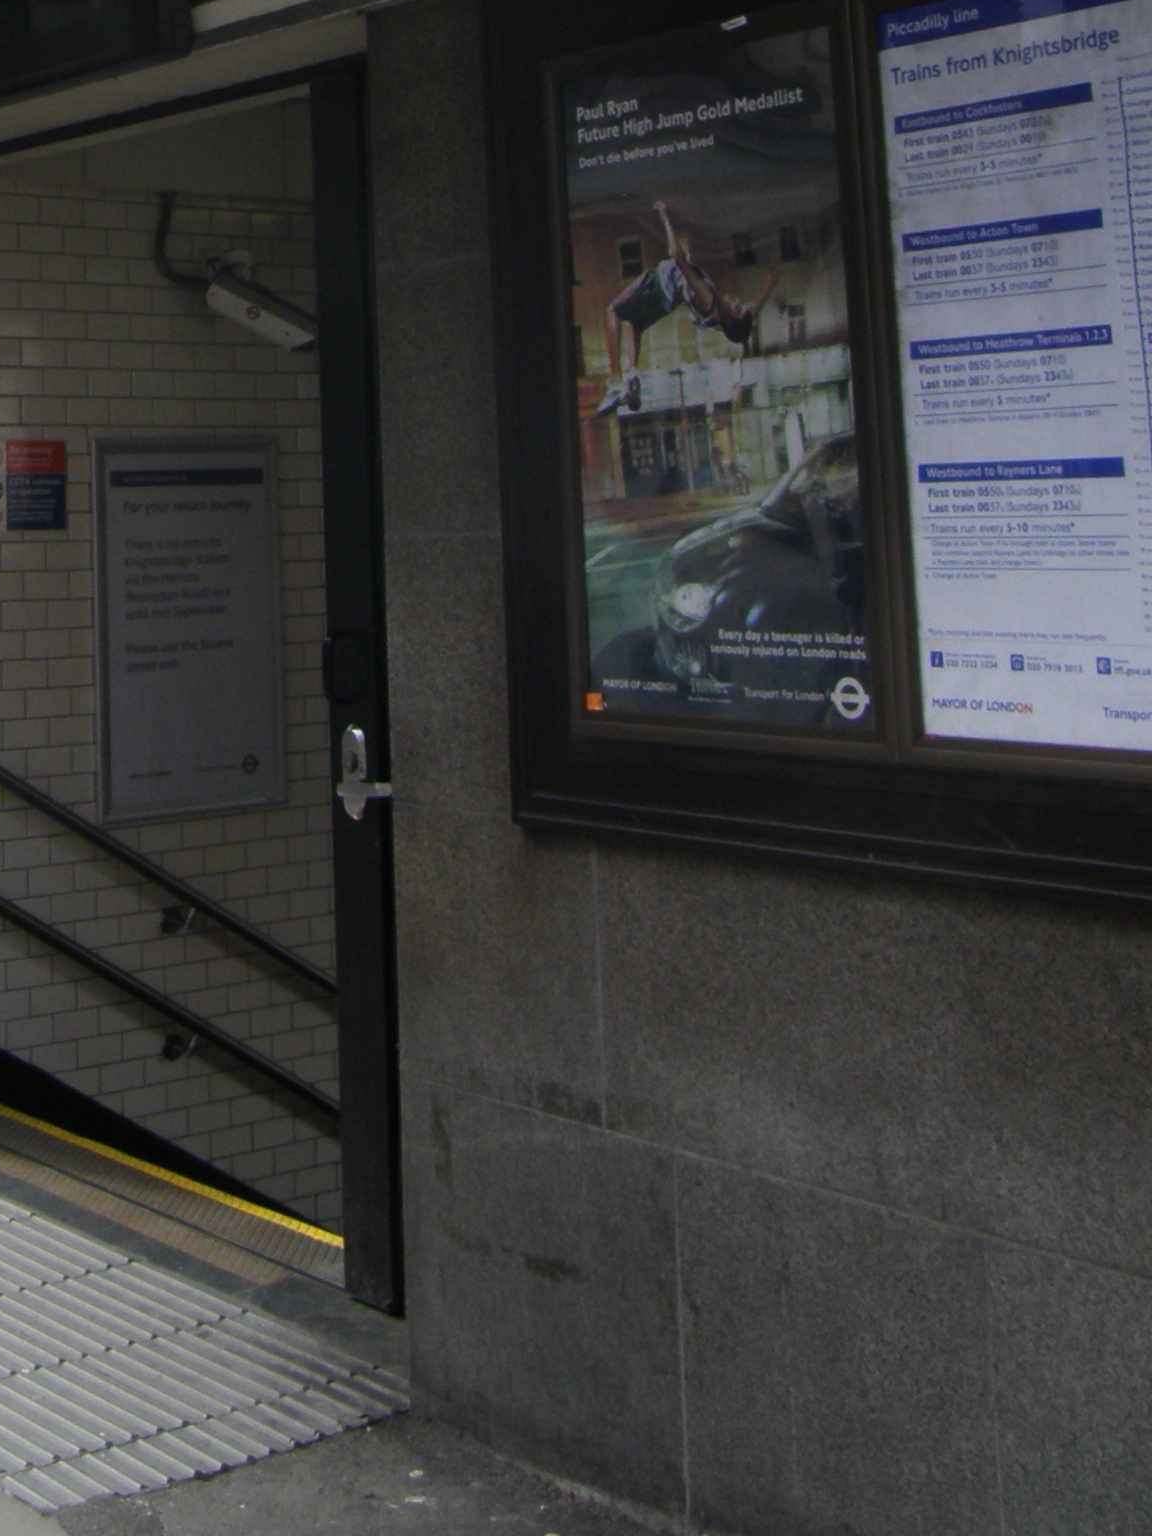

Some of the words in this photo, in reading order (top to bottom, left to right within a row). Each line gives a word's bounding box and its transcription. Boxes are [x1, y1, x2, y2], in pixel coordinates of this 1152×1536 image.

[886, 14, 949, 37] Piccadilly
[953, 7, 980, 24] line
[891, 63, 942, 85] Trains
[945, 52, 987, 75] from
[992, 27, 1120, 67] Knightsbridge
[576, 105, 604, 123] Paul
[607, 97, 639, 118] Ryan
[577, 126, 620, 145] Future
[623, 115, 653, 137] High
[656, 110, 694, 131] Jump
[697, 99, 731, 118] Gold
[734, 87, 805, 114] Medallist
[953, 108, 963, 120] to
[904, 137, 924, 148] First
[927, 133, 949, 144] train
[579, 154, 605, 169] Don't
[606, 149, 622, 164] die
[623, 145, 655, 161] before
[657, 141, 689, 157] you've
[690, 134, 715, 150] lived
[904, 151, 924, 163] Last
[927, 147, 949, 159] train
[910, 230, 964, 247] Westbound
[966, 228, 978, 240] to
[979, 225, 1009, 238] Acton
[1011, 221, 1039, 233] Town
[912, 255, 933, 266] First
[936, 253, 957, 264] train
[912, 270, 933, 282] Last
[936, 268, 957, 279] train
[915, 289, 942, 300] Trains
[945, 288, 960, 297] run
[963, 286, 987, 297] every
[918, 341, 971, 355] Westbound
[973, 340, 983, 351] to
[985, 336, 1034, 349] Heathrow
[1037, 331, 1082, 345] Terminals
[919, 363, 941, 374] First
[944, 363, 966, 373] train
[920, 379, 940, 390] Last
[943, 378, 966, 388] train
[922, 399, 950, 409] Trains
[952, 399, 967, 408] run
[970, 397, 994, 408] every
[926, 466, 981, 478] Westbound
[984, 466, 995, 477] to
[997, 464, 1036, 478] Rayners
[1038, 463, 1063, 475] Lane
[928, 488, 950, 498] First
[952, 487, 975, 497] train
[928, 502, 950, 513] Last
[952, 503, 975, 513] train
[930, 523, 958, 534] Trains
[960, 524, 976, 533] run
[979, 524, 1003, 535] every
[718, 627, 743, 643] Every
[744, 629, 762, 644] day
[772, 631, 813, 645] teenager
[814, 632, 824, 644] is
[825, 631, 852, 645] killed
[854, 634, 866, 645] or
[710, 642, 749, 657] seriously
[751, 644, 785, 659] injured
[787, 647, 799, 657] on
[801, 645, 837, 659] London
[839, 647, 867, 660] roads
[630, 679, 641, 691] OF
[641, 679, 678, 693] LONDON
[744, 686, 784, 701] Transport
[785, 688, 794, 699] for
[795, 689, 825, 701] London
[931, 697, 967, 710] MAYOR
[970, 699, 984, 711] OF
[986, 700, 1033, 714] LONDON
